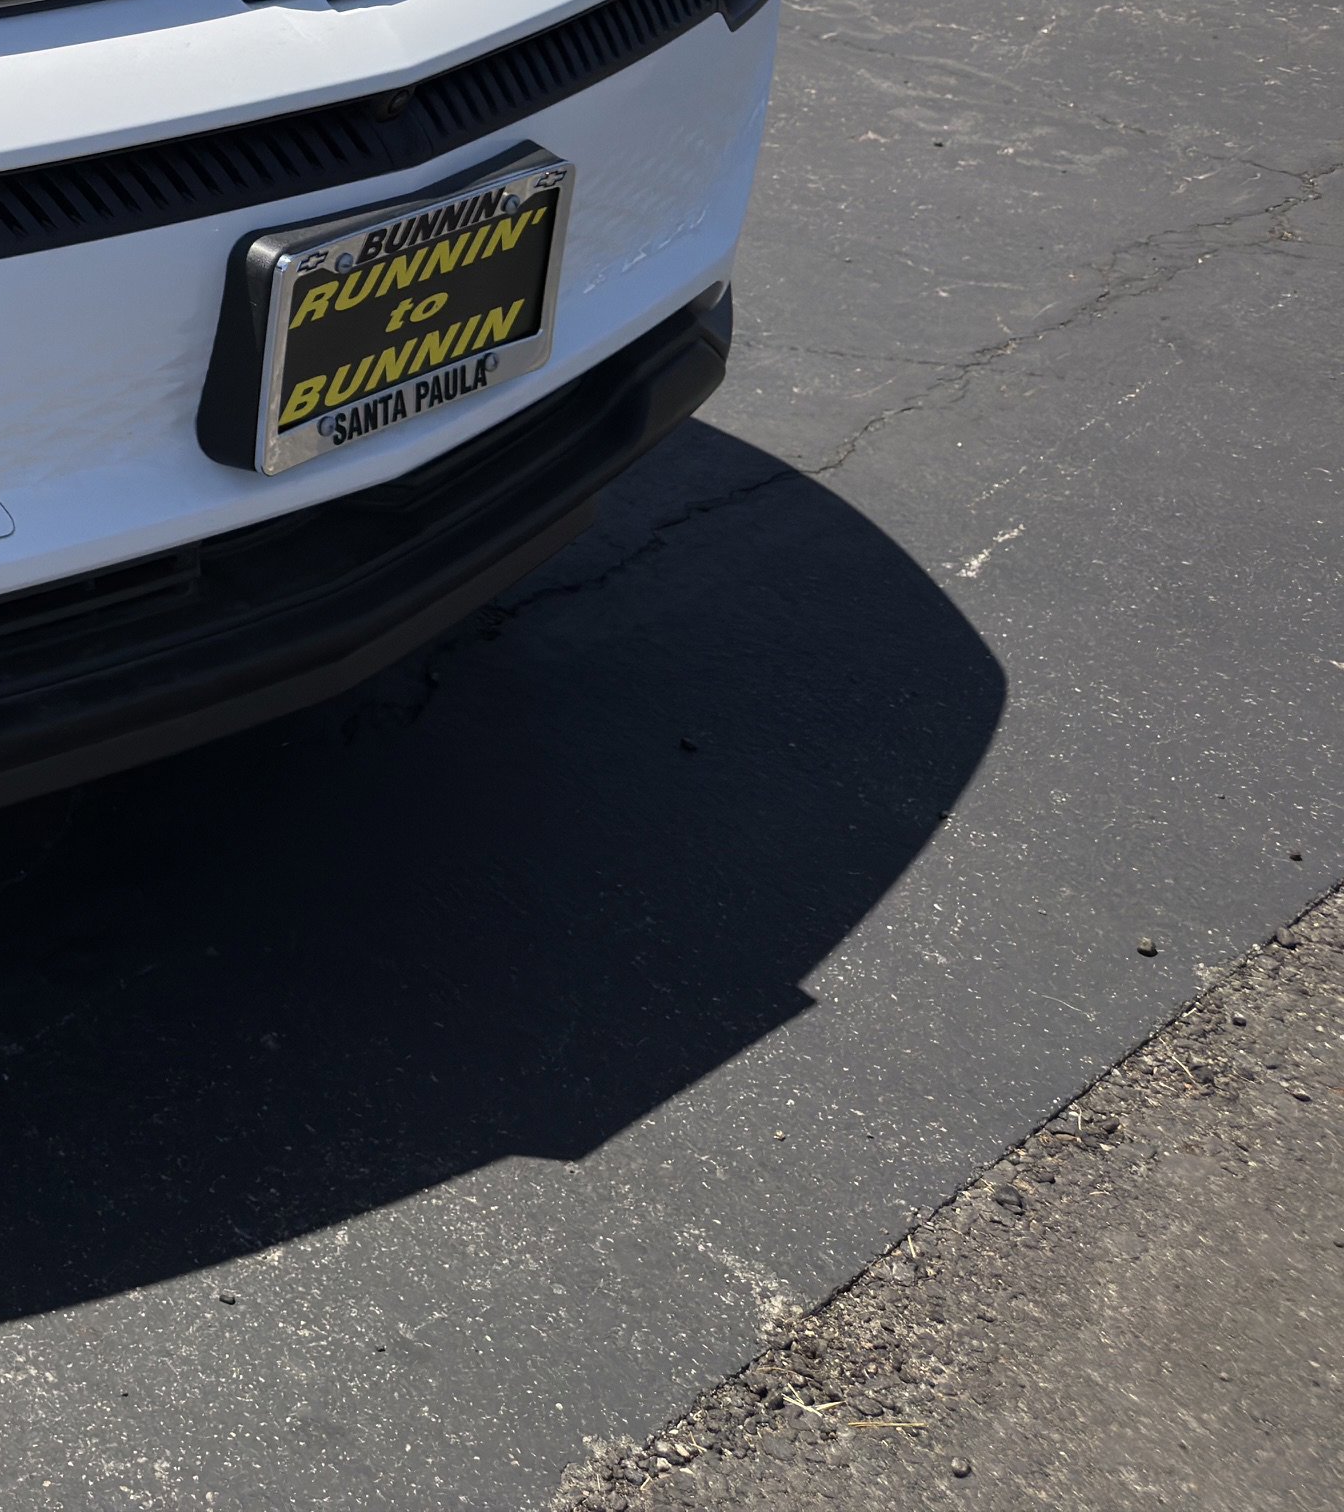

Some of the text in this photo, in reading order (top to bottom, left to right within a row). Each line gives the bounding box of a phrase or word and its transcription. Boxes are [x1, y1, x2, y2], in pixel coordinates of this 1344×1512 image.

[356, 187, 505, 261] BUNNIN
[289, 207, 548, 329] RUNNIN'
[385, 292, 449, 332] to
[278, 299, 525, 426] BUNNIN
[332, 359, 488, 445] SANTA PAULA
